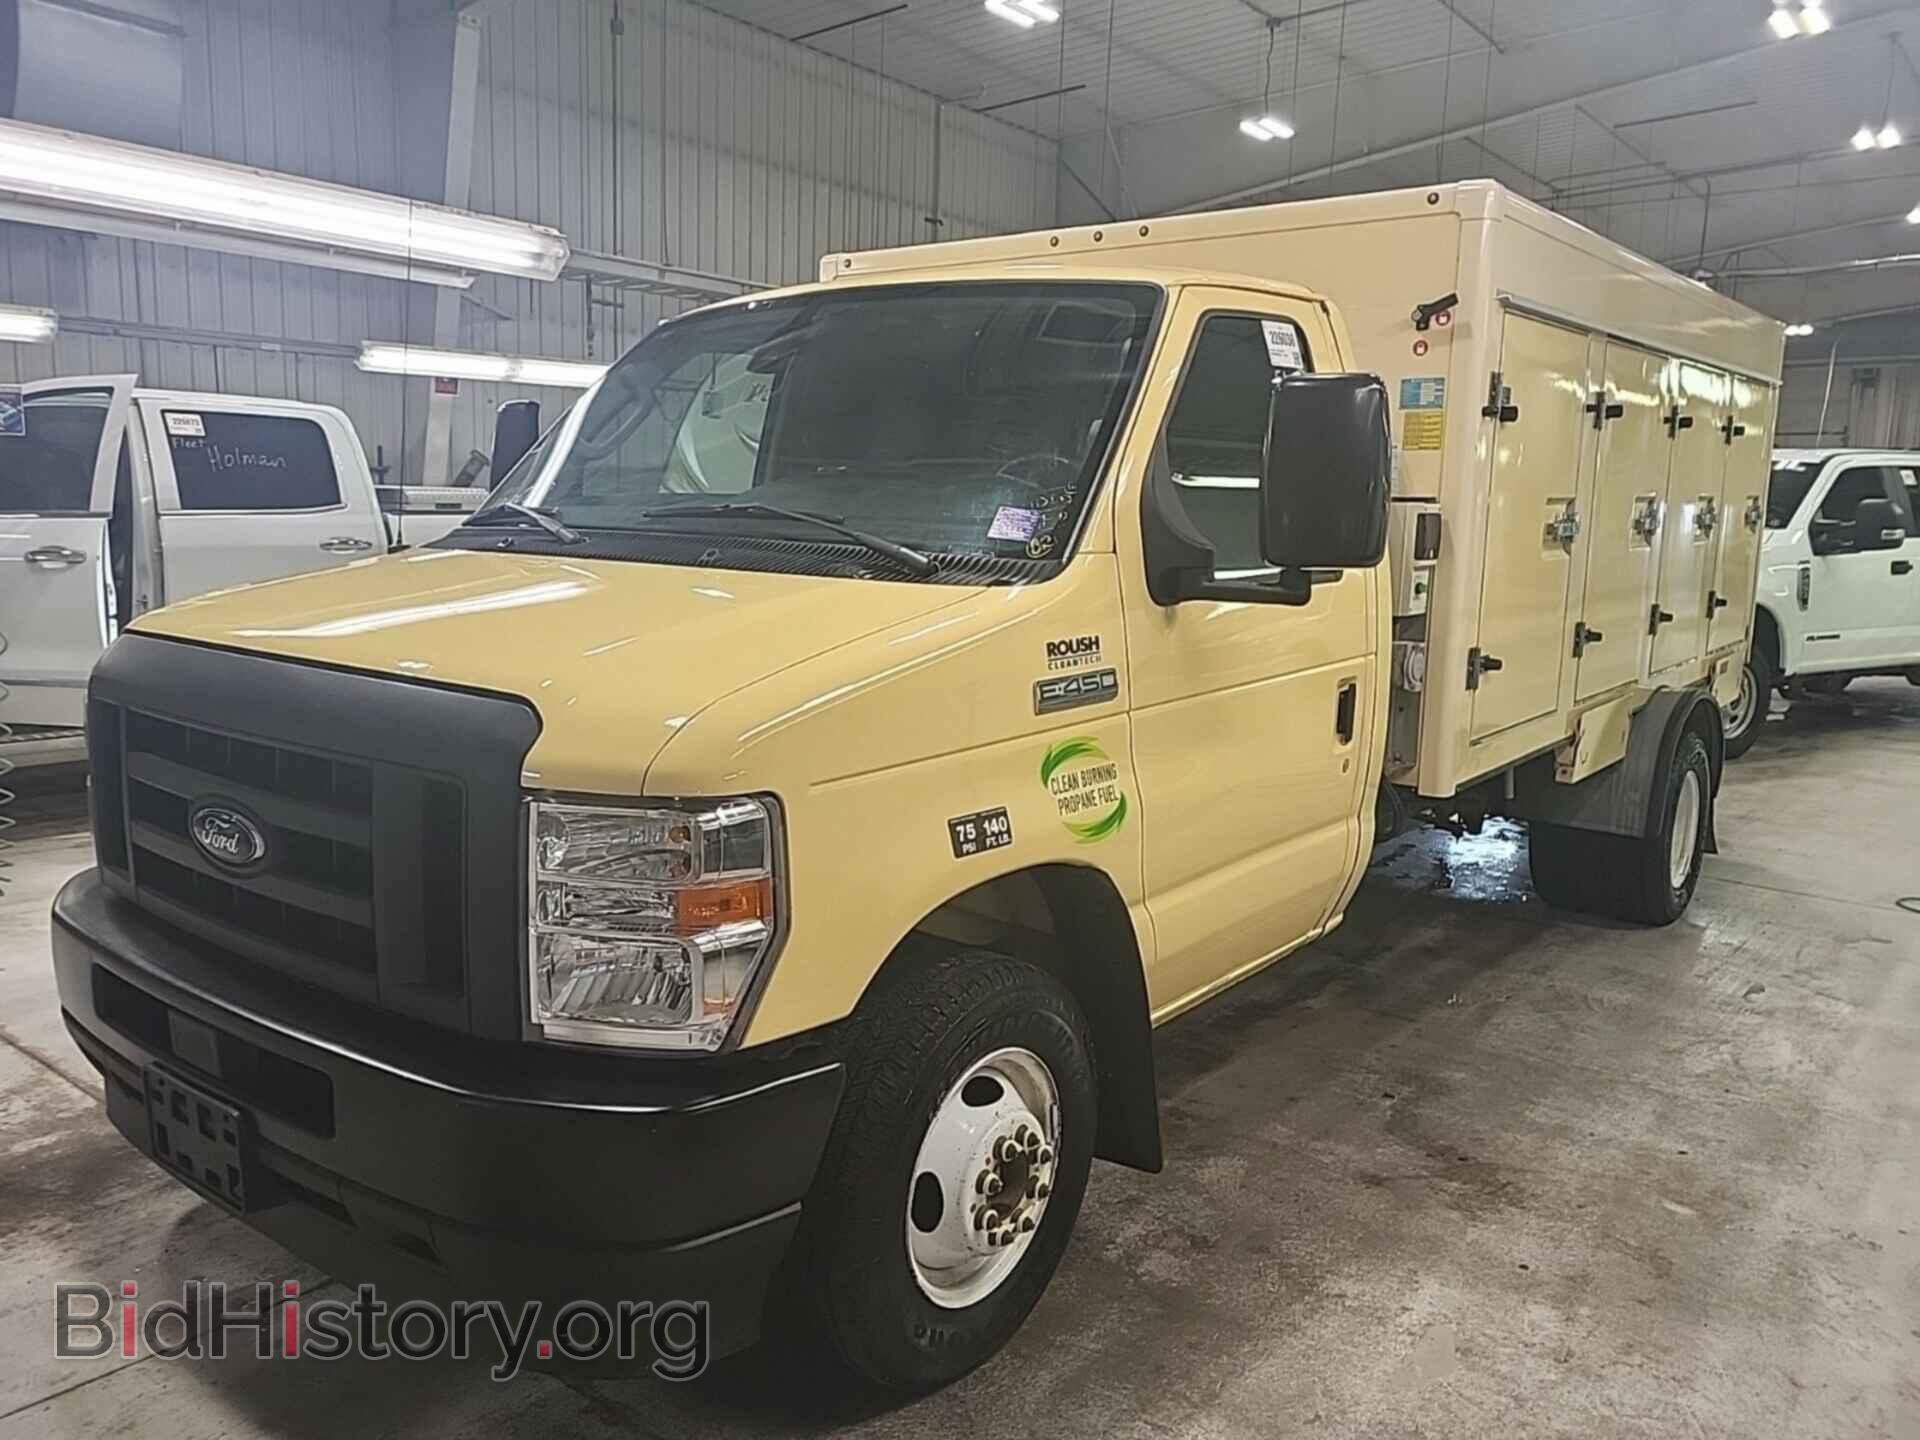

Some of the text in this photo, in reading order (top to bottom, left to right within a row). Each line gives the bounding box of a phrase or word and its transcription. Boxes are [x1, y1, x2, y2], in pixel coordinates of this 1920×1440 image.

[207, 443, 287, 473] Holman
[1046, 635, 1100, 658] ROUSH
[1047, 655, 1102, 671] CLEANTECH
[1050, 762, 1117, 796] CLEAN BURNING
[1057, 783, 1120, 816] PROPANE FUEL
[201, 816, 240, 854] Ford
[955, 822, 977, 842] 75
[983, 815, 1008, 836] 140
[962, 841, 977, 854] PSI
